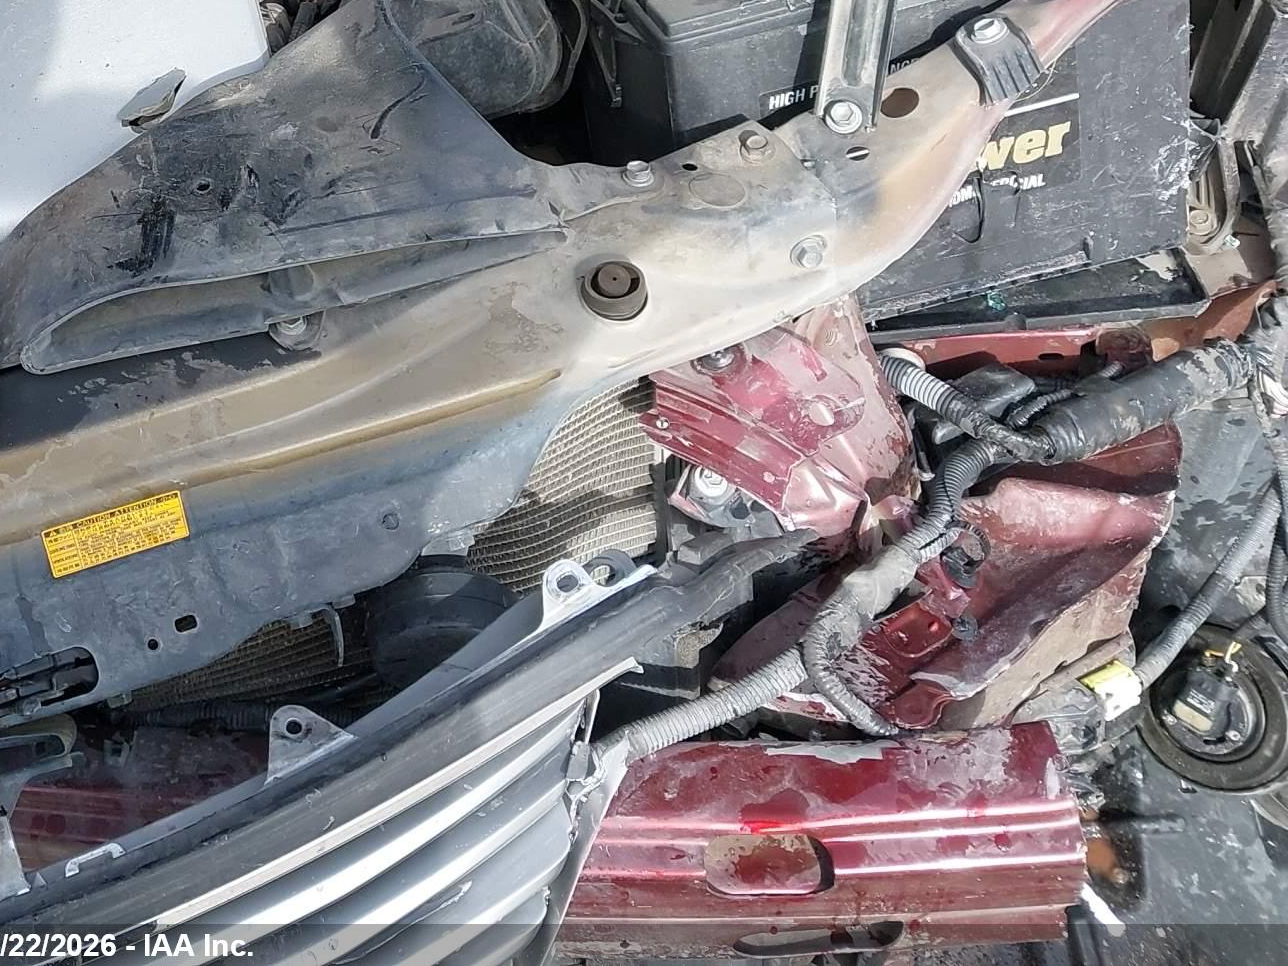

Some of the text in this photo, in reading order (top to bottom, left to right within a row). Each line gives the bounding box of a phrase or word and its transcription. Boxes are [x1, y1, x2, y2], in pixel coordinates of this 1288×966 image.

[768, 88, 806, 110] HIGH
[980, 121, 1071, 170] wer
[76, 513, 111, 528] CAUTION
[114, 500, 157, 517] ATTENTION
